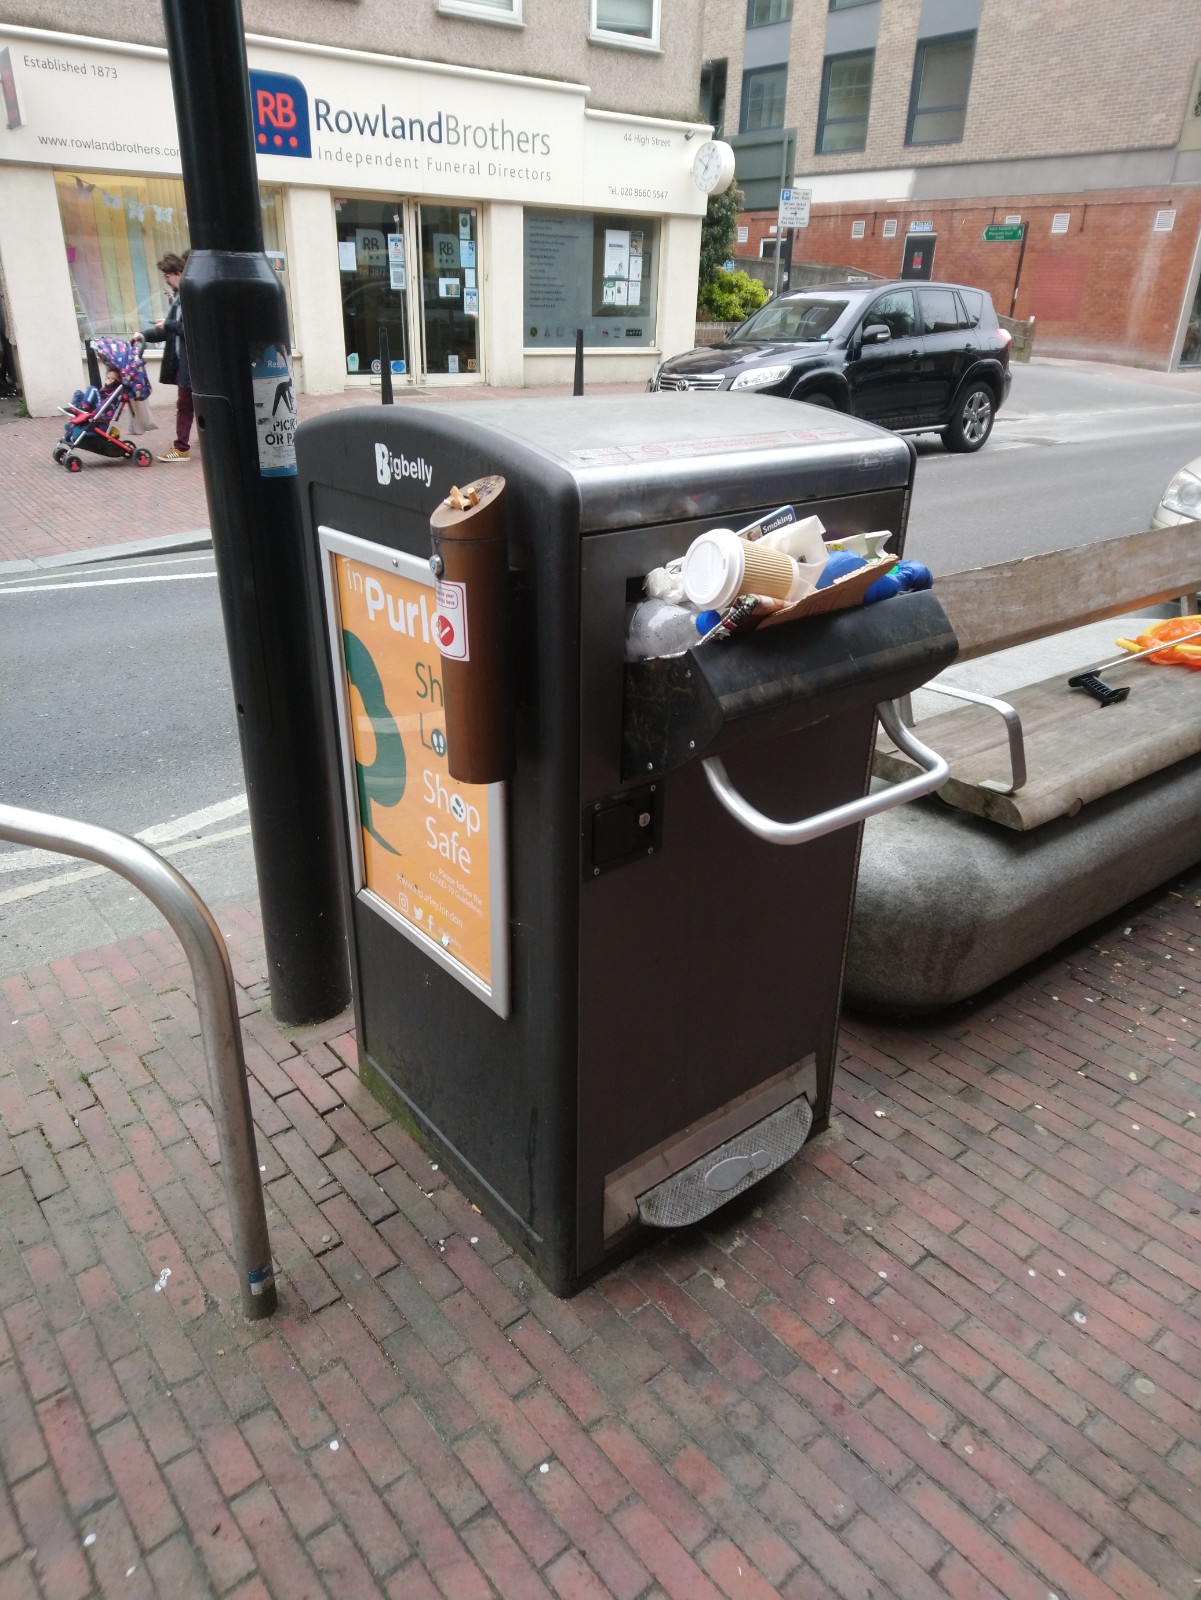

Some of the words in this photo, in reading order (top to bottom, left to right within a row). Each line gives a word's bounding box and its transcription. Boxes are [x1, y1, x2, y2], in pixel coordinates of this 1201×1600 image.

[23, 55, 87, 75] Established
[91, 65, 118, 79] 1873
[256, 90, 297, 128] RB
[314, 98, 551, 156] RowlandBrothers
[623, 133, 633, 142] 44
[633, 134, 650, 147] High
[651, 137, 671, 147] Street
[318, 146, 420, 170] Independent
[427, 157, 481, 175] Funeral
[488, 163, 551, 182] Directors
[620, 187, 633, 197] 020
[652, 191, 669, 200] 5547
[363, 237, 379, 251] RB
[439, 241, 455, 256] RB
[265, 433, 284, 446] OR
[374, 442, 433, 488] Bigbelly
[762, 513, 793, 534] Smoking
[423, 769, 481, 837] Shop
[425, 816, 472, 874] Safe
[429, 871, 455, 895] COVID-19
[454, 890, 484, 917] Guidelines
[438, 867, 456, 885] Please
[473, 894, 483, 906] the
